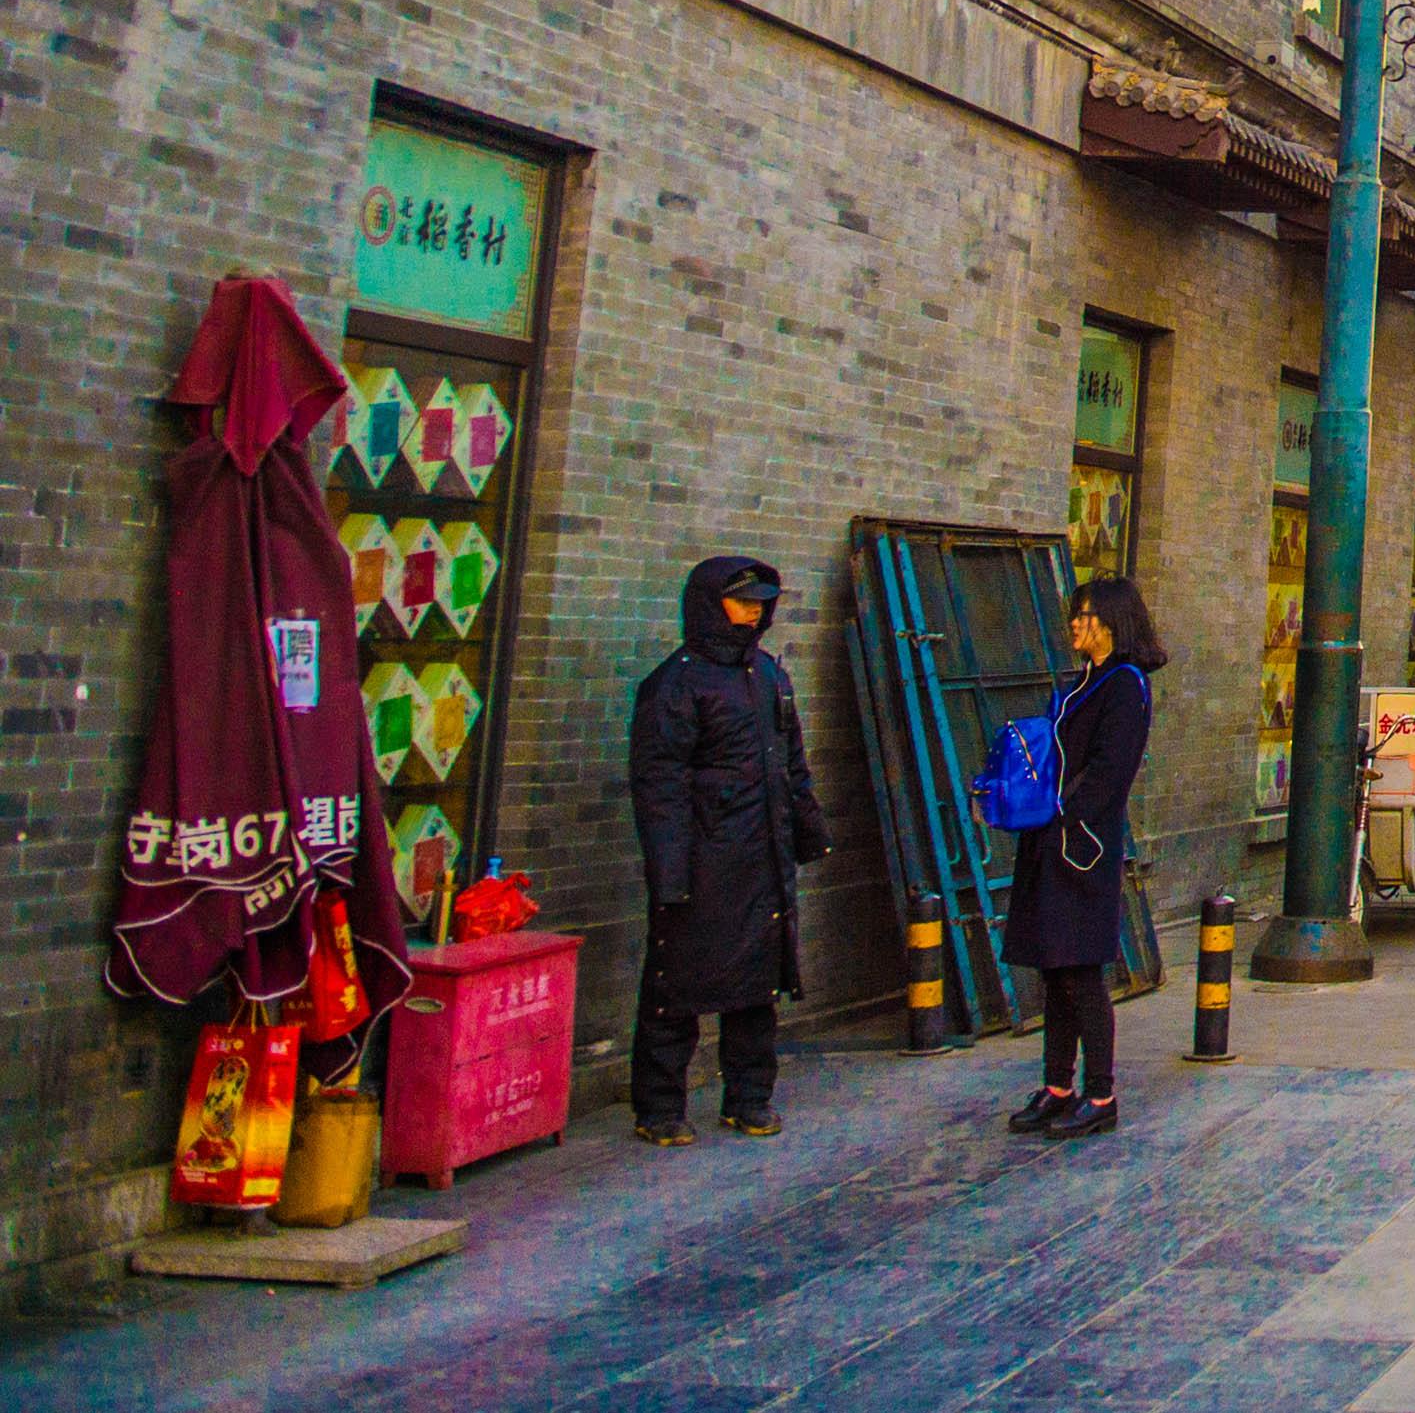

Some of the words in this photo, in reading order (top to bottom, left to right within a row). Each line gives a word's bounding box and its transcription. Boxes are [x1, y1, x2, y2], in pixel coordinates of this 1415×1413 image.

[416, 199, 506, 266] 稻香村
[128, 810, 289, 874] 守岗67
